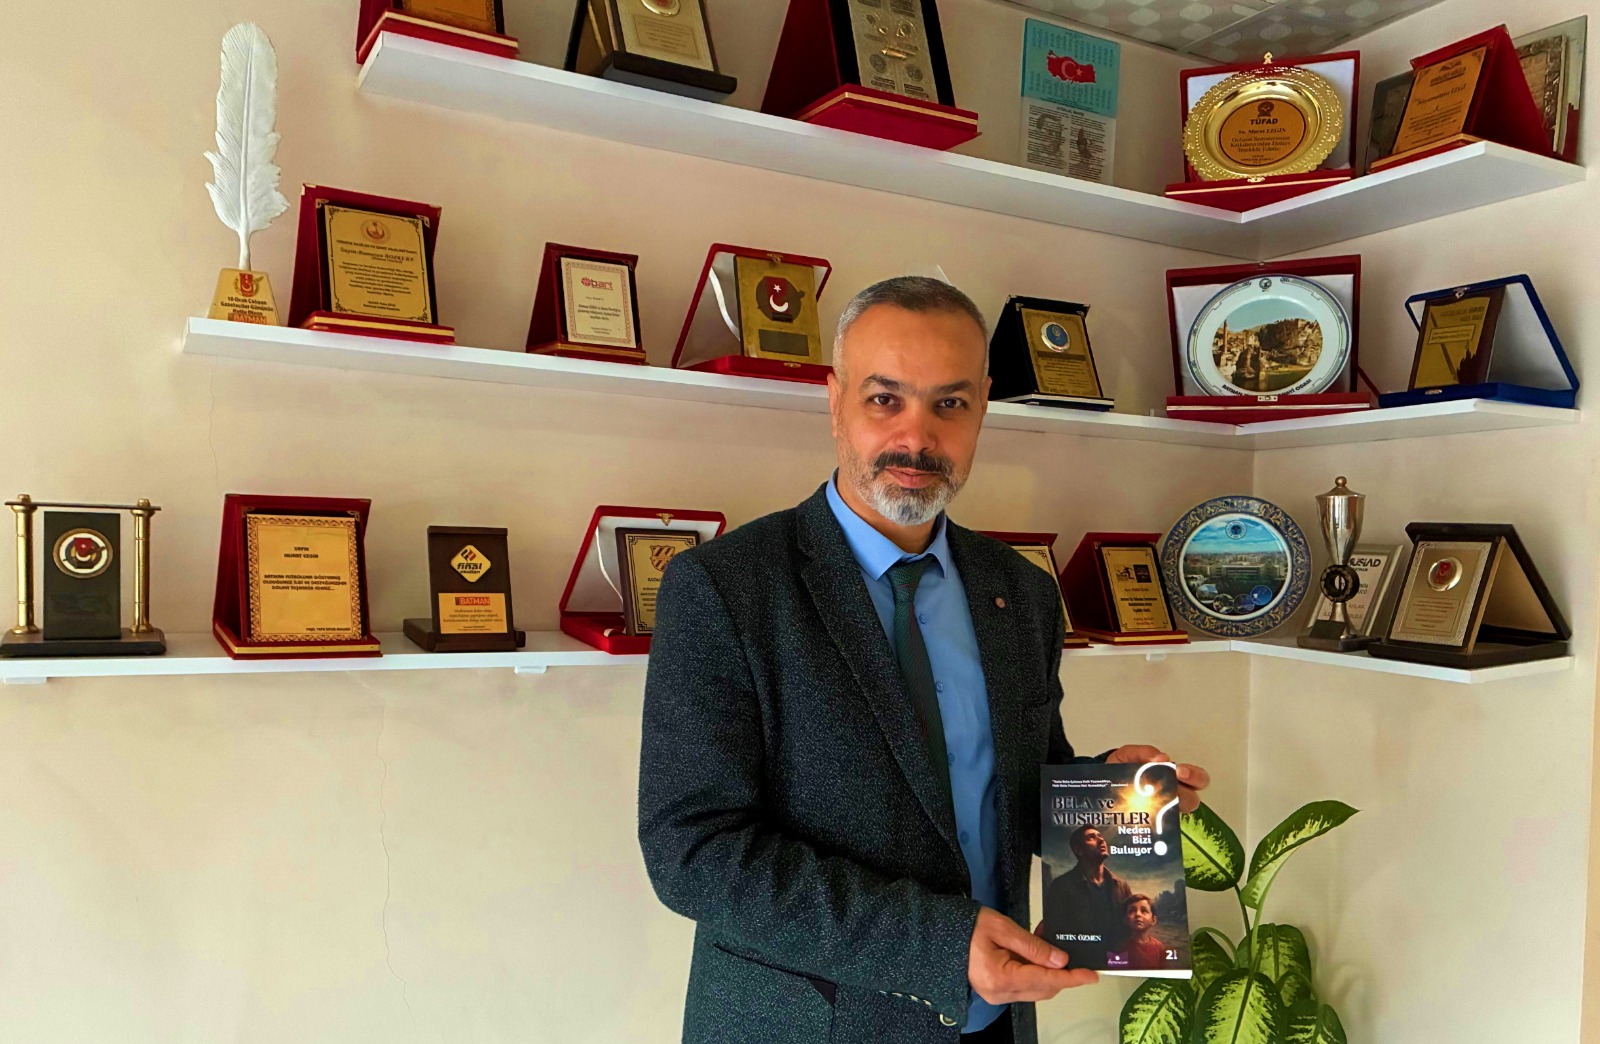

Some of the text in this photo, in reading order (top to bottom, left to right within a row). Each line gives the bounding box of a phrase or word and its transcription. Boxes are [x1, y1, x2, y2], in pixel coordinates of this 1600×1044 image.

[457, 562, 482, 570] final
[460, 597, 491, 606] BATMAN
[1053, 796, 1115, 810] BELA ve
[1118, 825, 1151, 835] Neden
[1132, 835, 1152, 844] Bizi
[1110, 845, 1153, 857] Buluyor
[1055, 933, 1102, 942] METİN ÖZMEN
